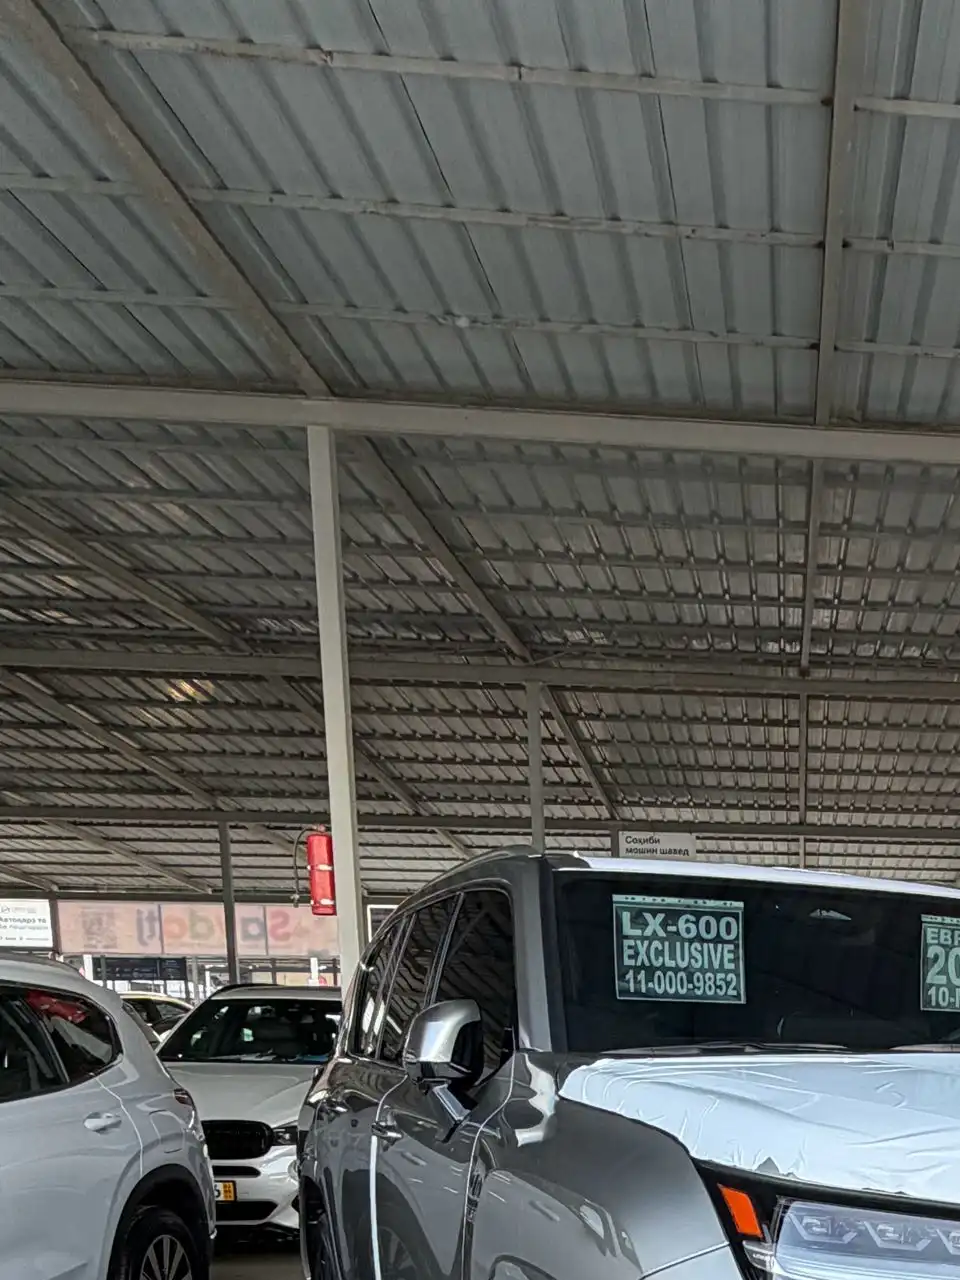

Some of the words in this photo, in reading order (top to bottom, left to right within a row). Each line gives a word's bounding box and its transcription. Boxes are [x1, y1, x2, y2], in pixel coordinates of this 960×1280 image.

[622, 911, 738, 940] LX-600
[623, 940, 736, 969] EXCLUSIVE
[625, 969, 738, 996] 11-000-9852
